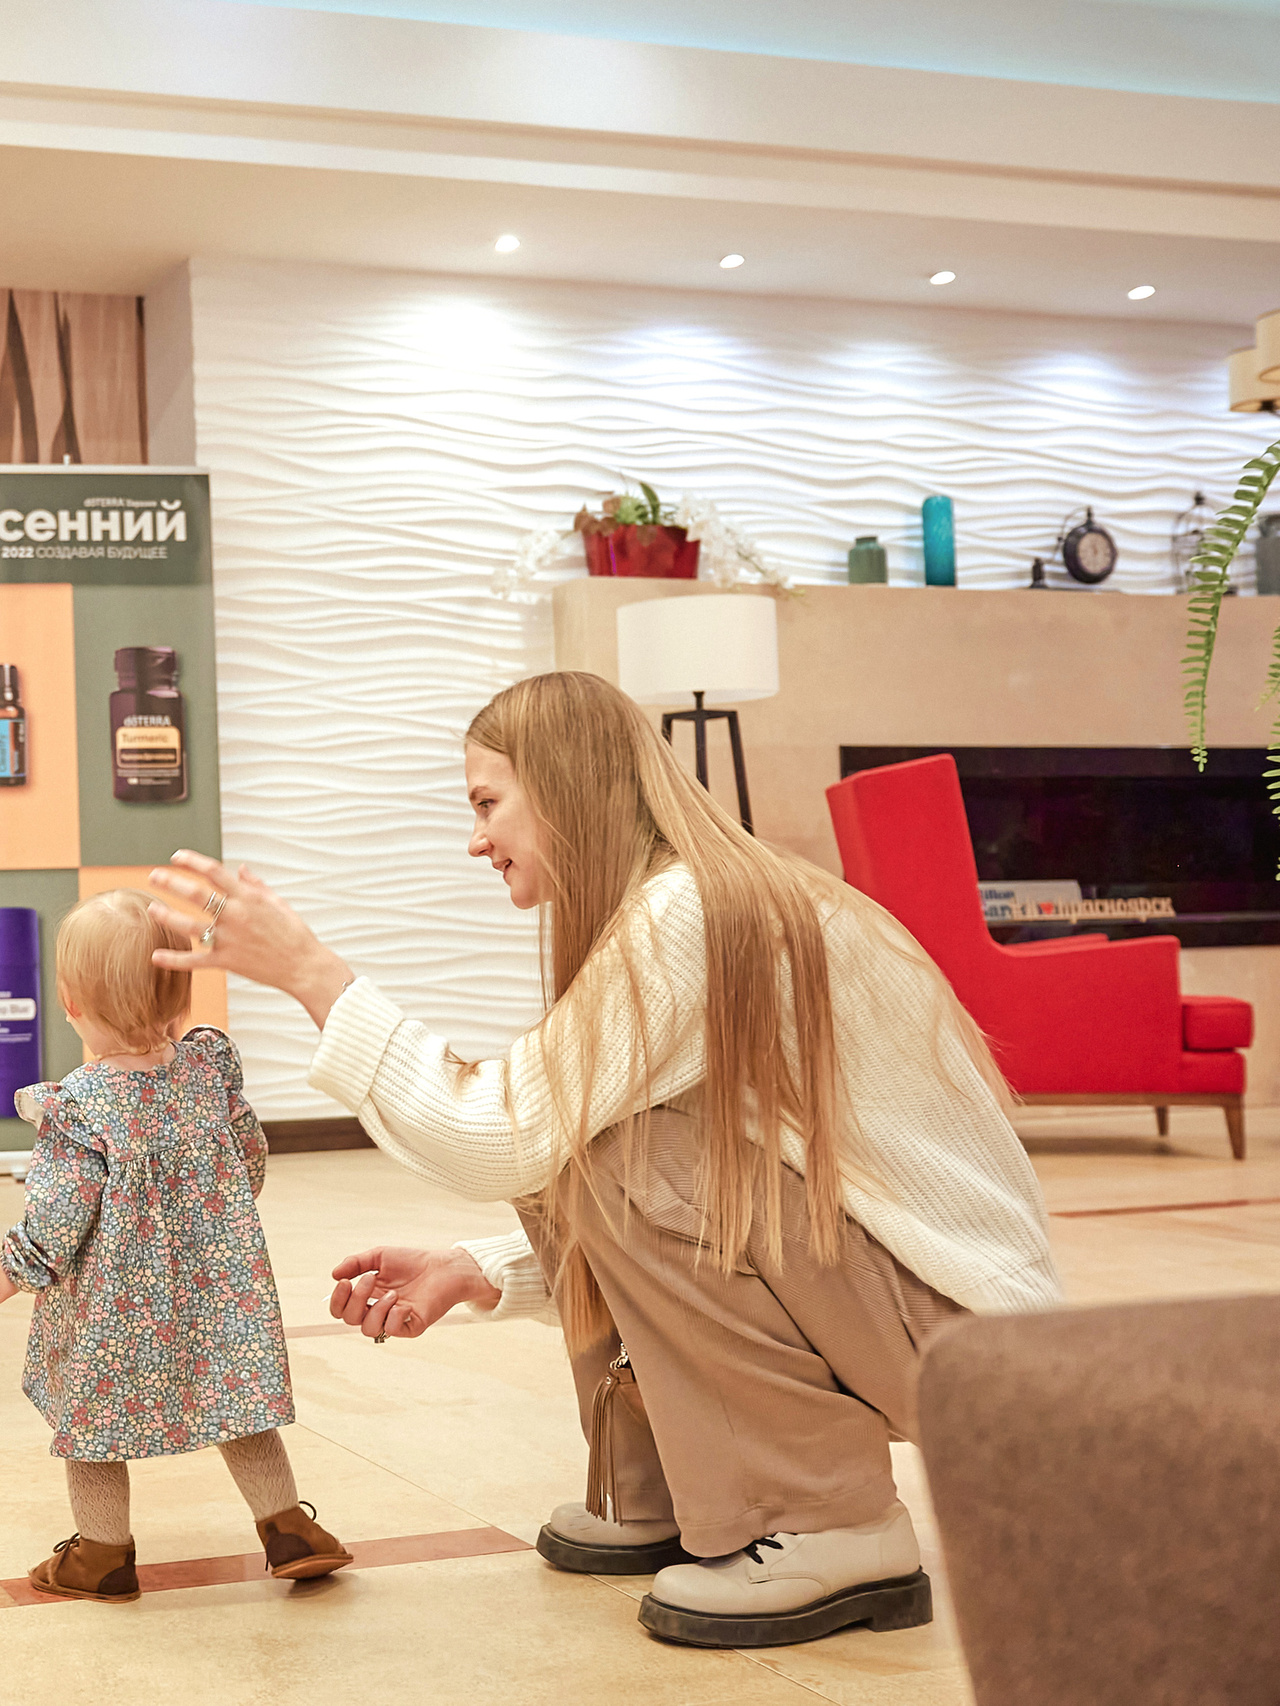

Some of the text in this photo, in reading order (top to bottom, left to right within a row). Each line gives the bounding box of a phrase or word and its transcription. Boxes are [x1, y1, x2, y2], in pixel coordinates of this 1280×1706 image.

[1, 546, 35, 558] 2022
[36, 546, 105, 559] СОЗДАВАЯ
[107, 546, 168, 559] БУДУЩЕЕ
